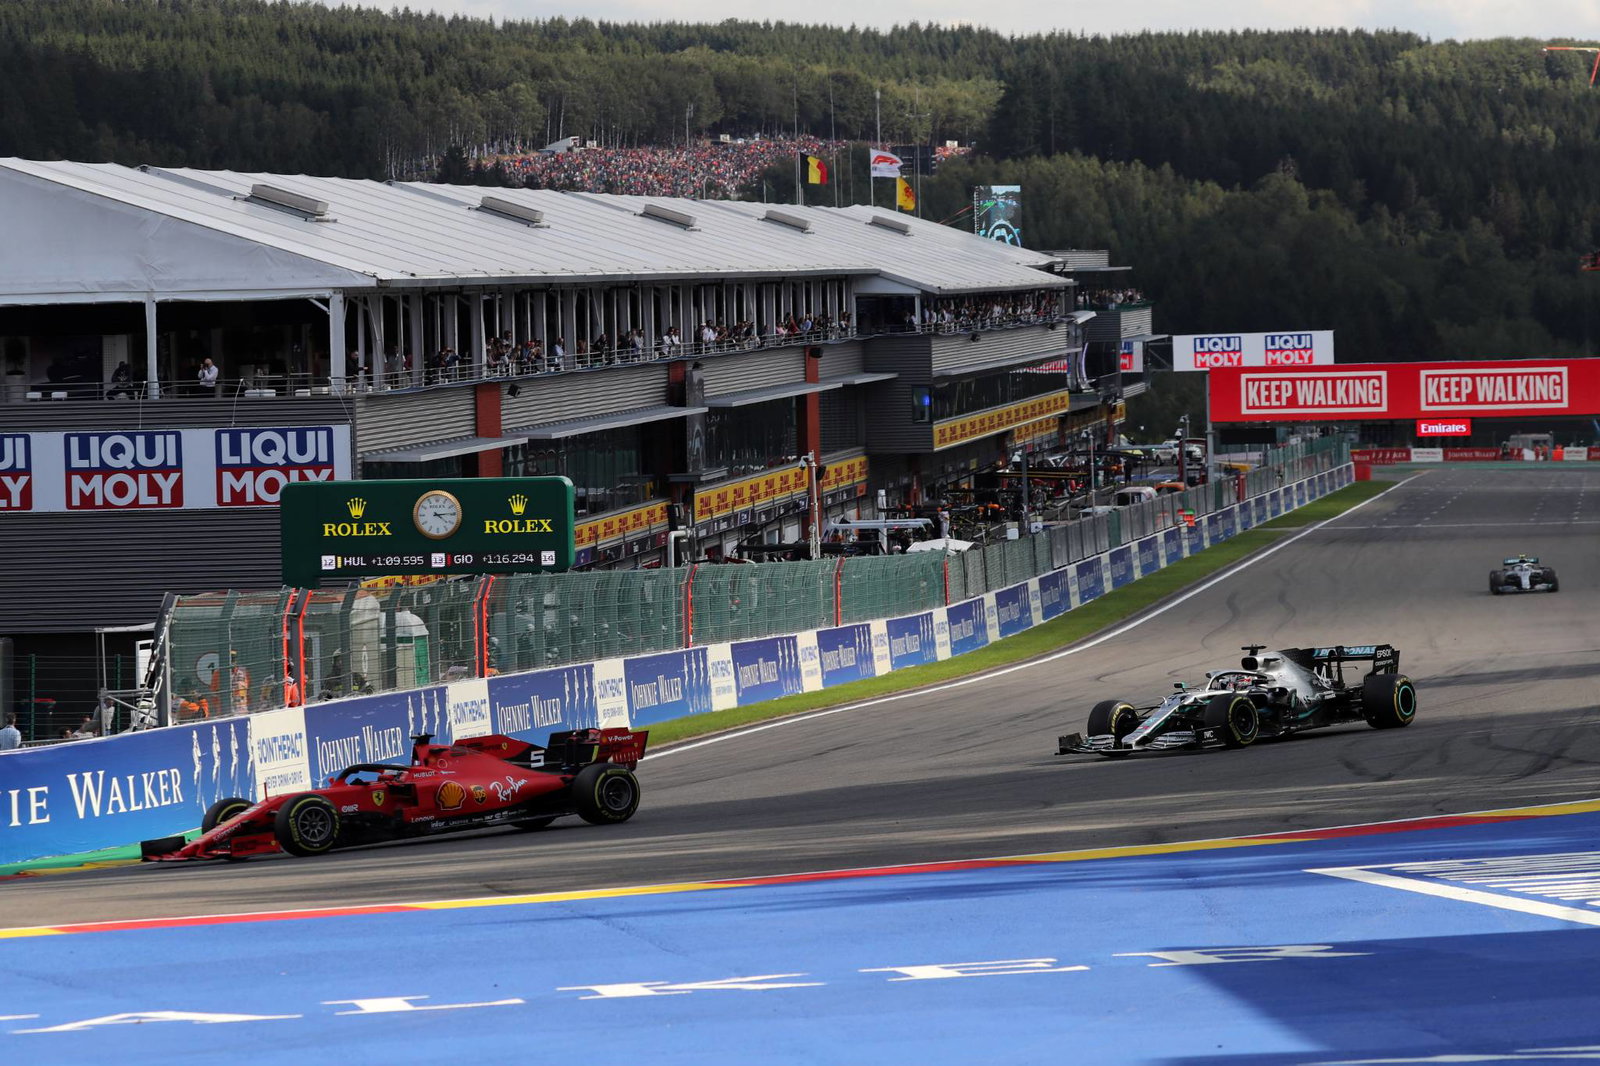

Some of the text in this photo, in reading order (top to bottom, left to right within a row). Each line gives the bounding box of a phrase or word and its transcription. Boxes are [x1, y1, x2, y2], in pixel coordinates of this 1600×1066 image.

[1195, 337, 1240, 352] LIQUI
[1266, 335, 1311, 349] LIQUI
[1196, 353, 1241, 367] MOLY
[1267, 350, 1312, 364] MOLY
[1248, 379, 1380, 406] KEEP WALKING
[1427, 375, 1561, 402] KEEP WALKING
[1420, 422, 1466, 434] Emirates
[70, 434, 177, 469] LIQUI
[221, 430, 329, 466] LIQUI
[0, 475, 30, 507] Y
[71, 472, 181, 506] MOLY
[323, 522, 392, 537] ROLEX
[484, 519, 553, 534] ROLEX
[344, 556, 367, 566] HUL
[371, 556, 424, 567] +1:09.595
[454, 554, 473, 564] GIO
[482, 553, 534, 564] +1:16.294
[631, 675, 682, 719] JOHNNIE WALKER
[496, 695, 562, 735] JOHNNIE WALKER
[316, 725, 404, 788] JOHNNIE WALKER
[530, 749, 545, 768] 5
[0, 769, 184, 827] IE WALKER
[489, 775, 528, 802] Ray-Ban
[411, 815, 435, 824] Lenovo
